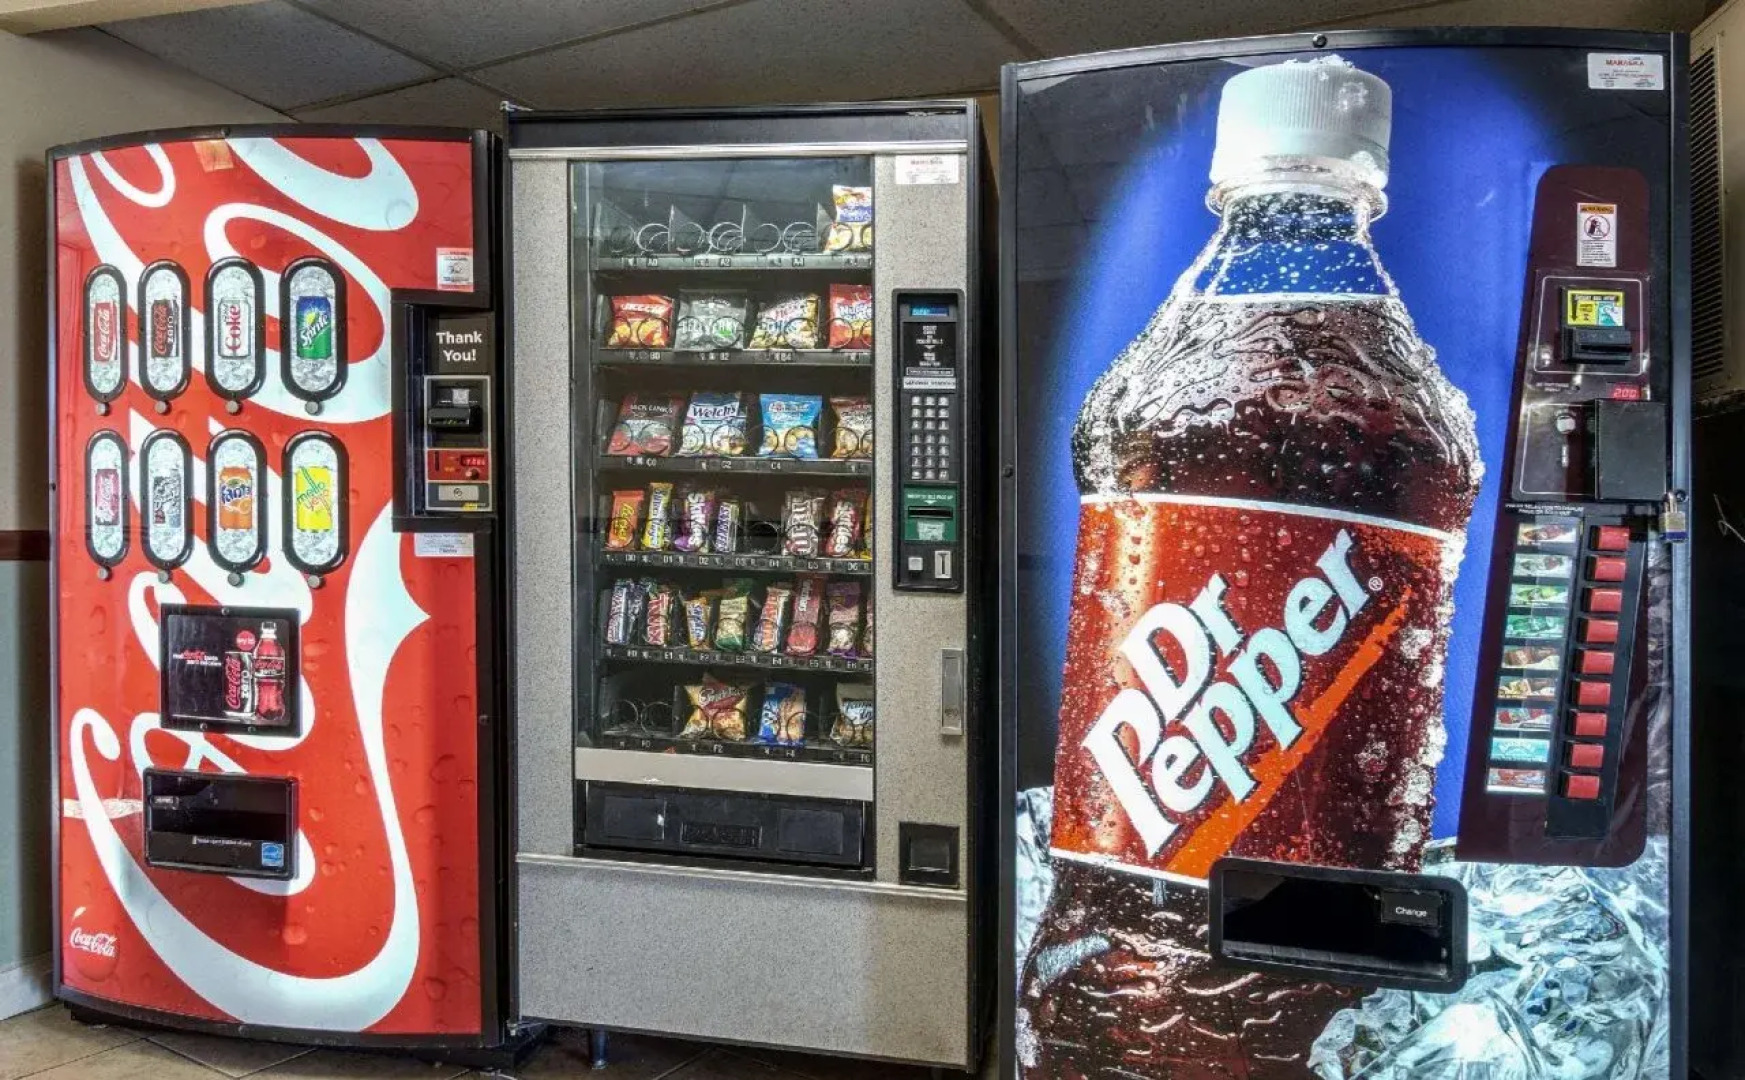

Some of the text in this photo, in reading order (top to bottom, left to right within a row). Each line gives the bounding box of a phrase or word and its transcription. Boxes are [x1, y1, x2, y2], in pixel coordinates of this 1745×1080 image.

[225, 304, 241, 352] Coke
[300, 311, 328, 349] Sprite
[436, 331, 482, 344] Thank
[443, 348, 477, 361] You!
[692, 404, 737, 419] Welch's
[221, 484, 252, 504] Fanta
[687, 493, 706, 547] Skittles
[1120, 573, 1242, 720] Dr
[225, 655, 241, 709] Coca-Cola
[241, 670, 251, 698] zero
[1082, 529, 1369, 858] Pepper
[1395, 906, 1428, 918] Change
[70, 927, 117, 957] Coca-Cola
